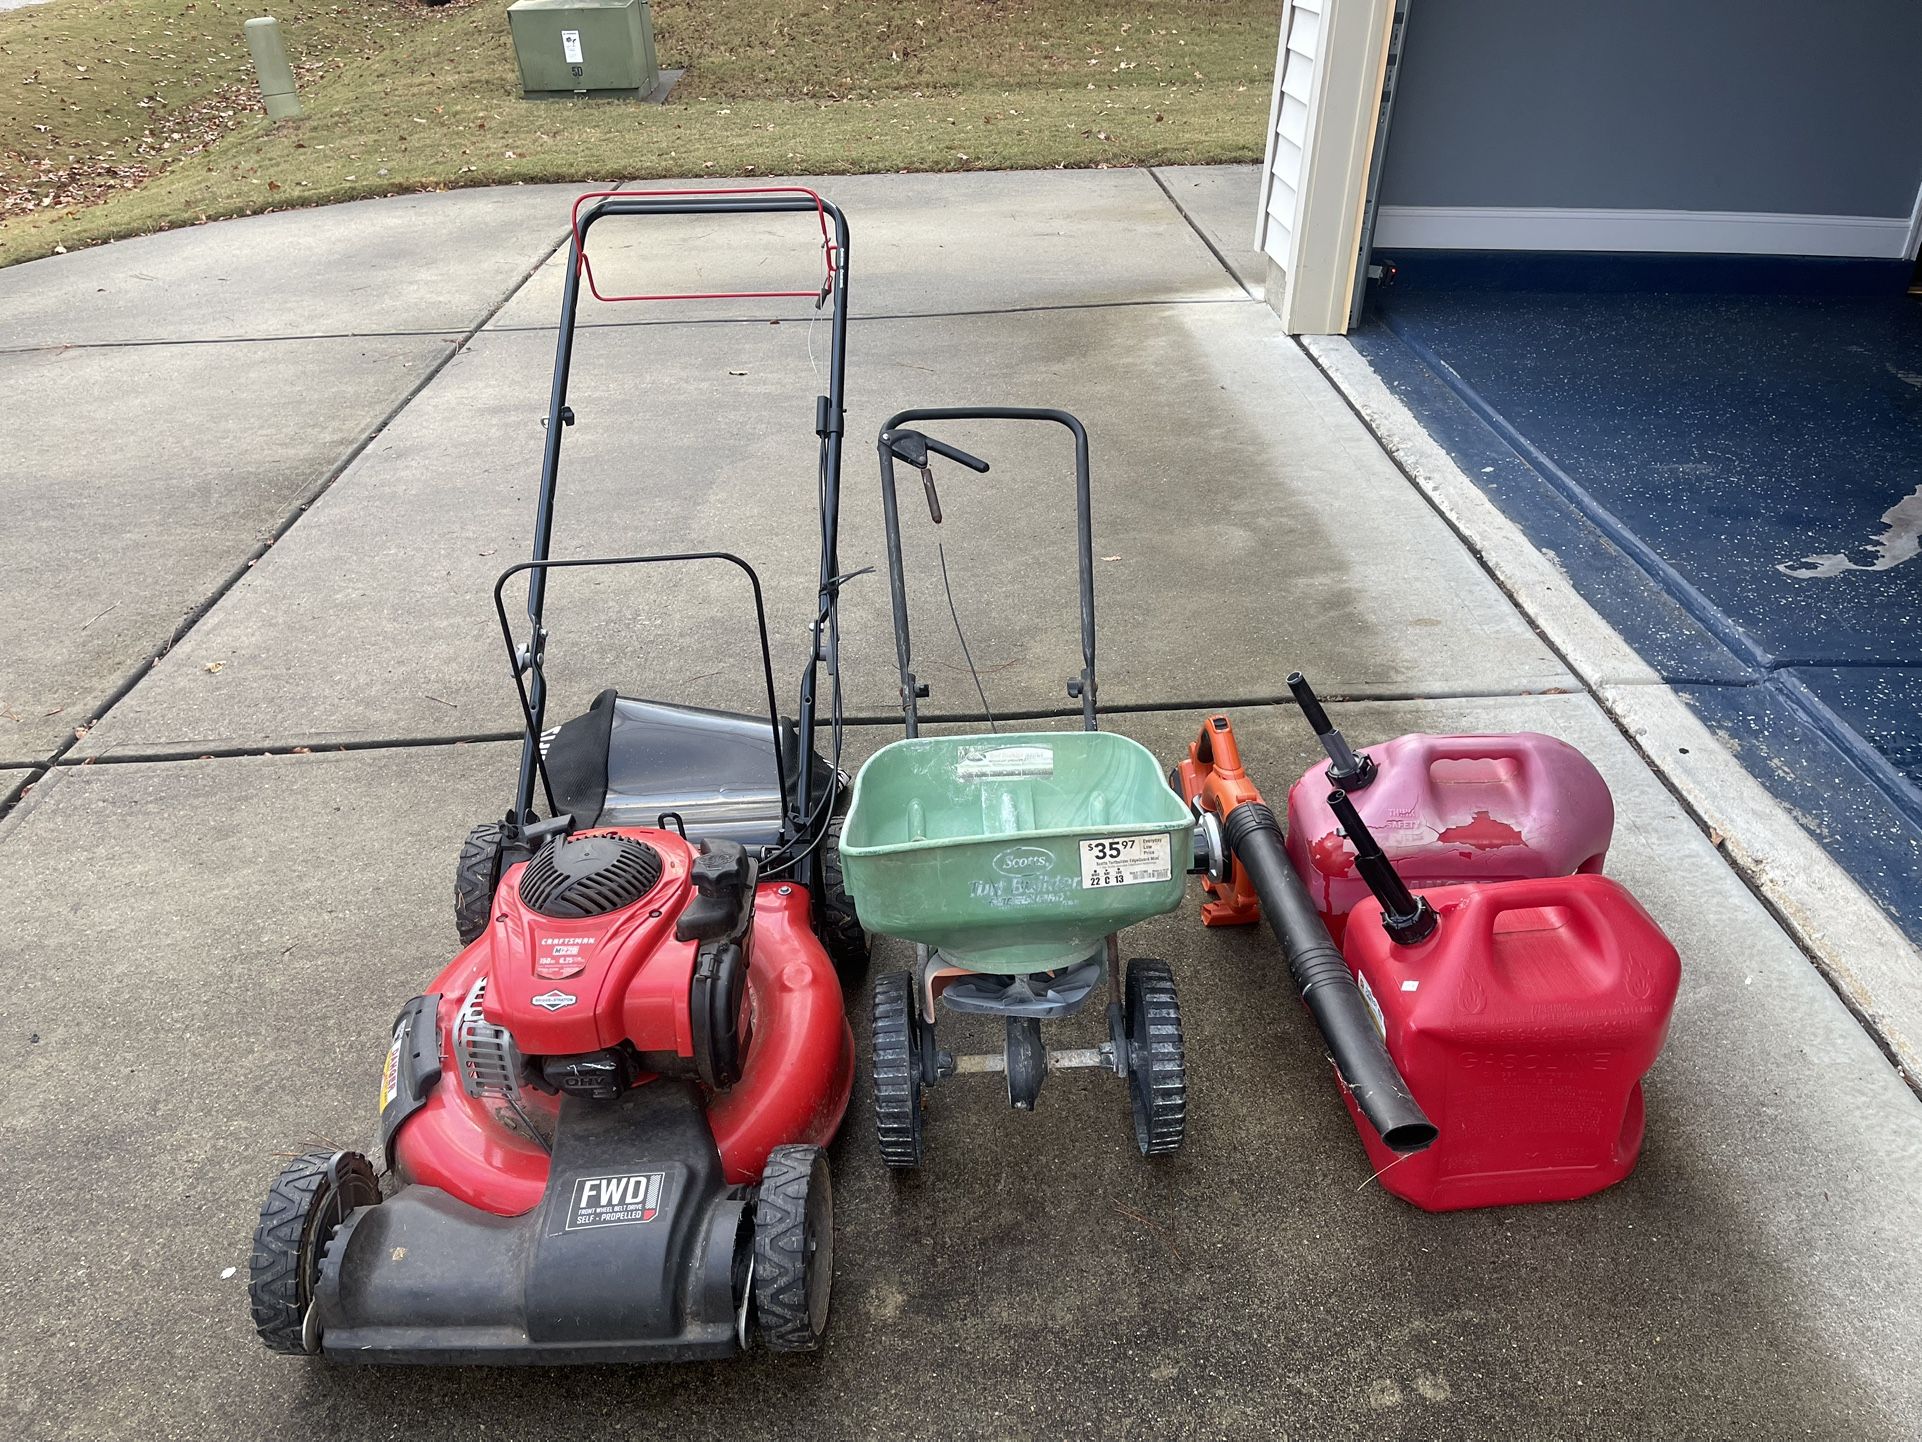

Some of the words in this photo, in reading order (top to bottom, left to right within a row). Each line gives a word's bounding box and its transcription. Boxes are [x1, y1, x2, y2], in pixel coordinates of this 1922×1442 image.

[1386, 820, 1420, 830] SAFETY
[1090, 876, 1101, 886] 22
[1104, 875, 1111, 885] C
[1114, 874, 1124, 884] 13
[541, 937, 596, 945] CRAFTSMAN
[1457, 1051, 1612, 1070] GASOLINE
[387, 1047, 400, 1093] DANGER
[564, 1076, 605, 1088] OHV
[579, 1176, 648, 1208] FWD
[627, 1203, 643, 1211] DRIVE
[576, 1215, 594, 1224] SELF
[601, 1210, 642, 1221] PROPELLED
